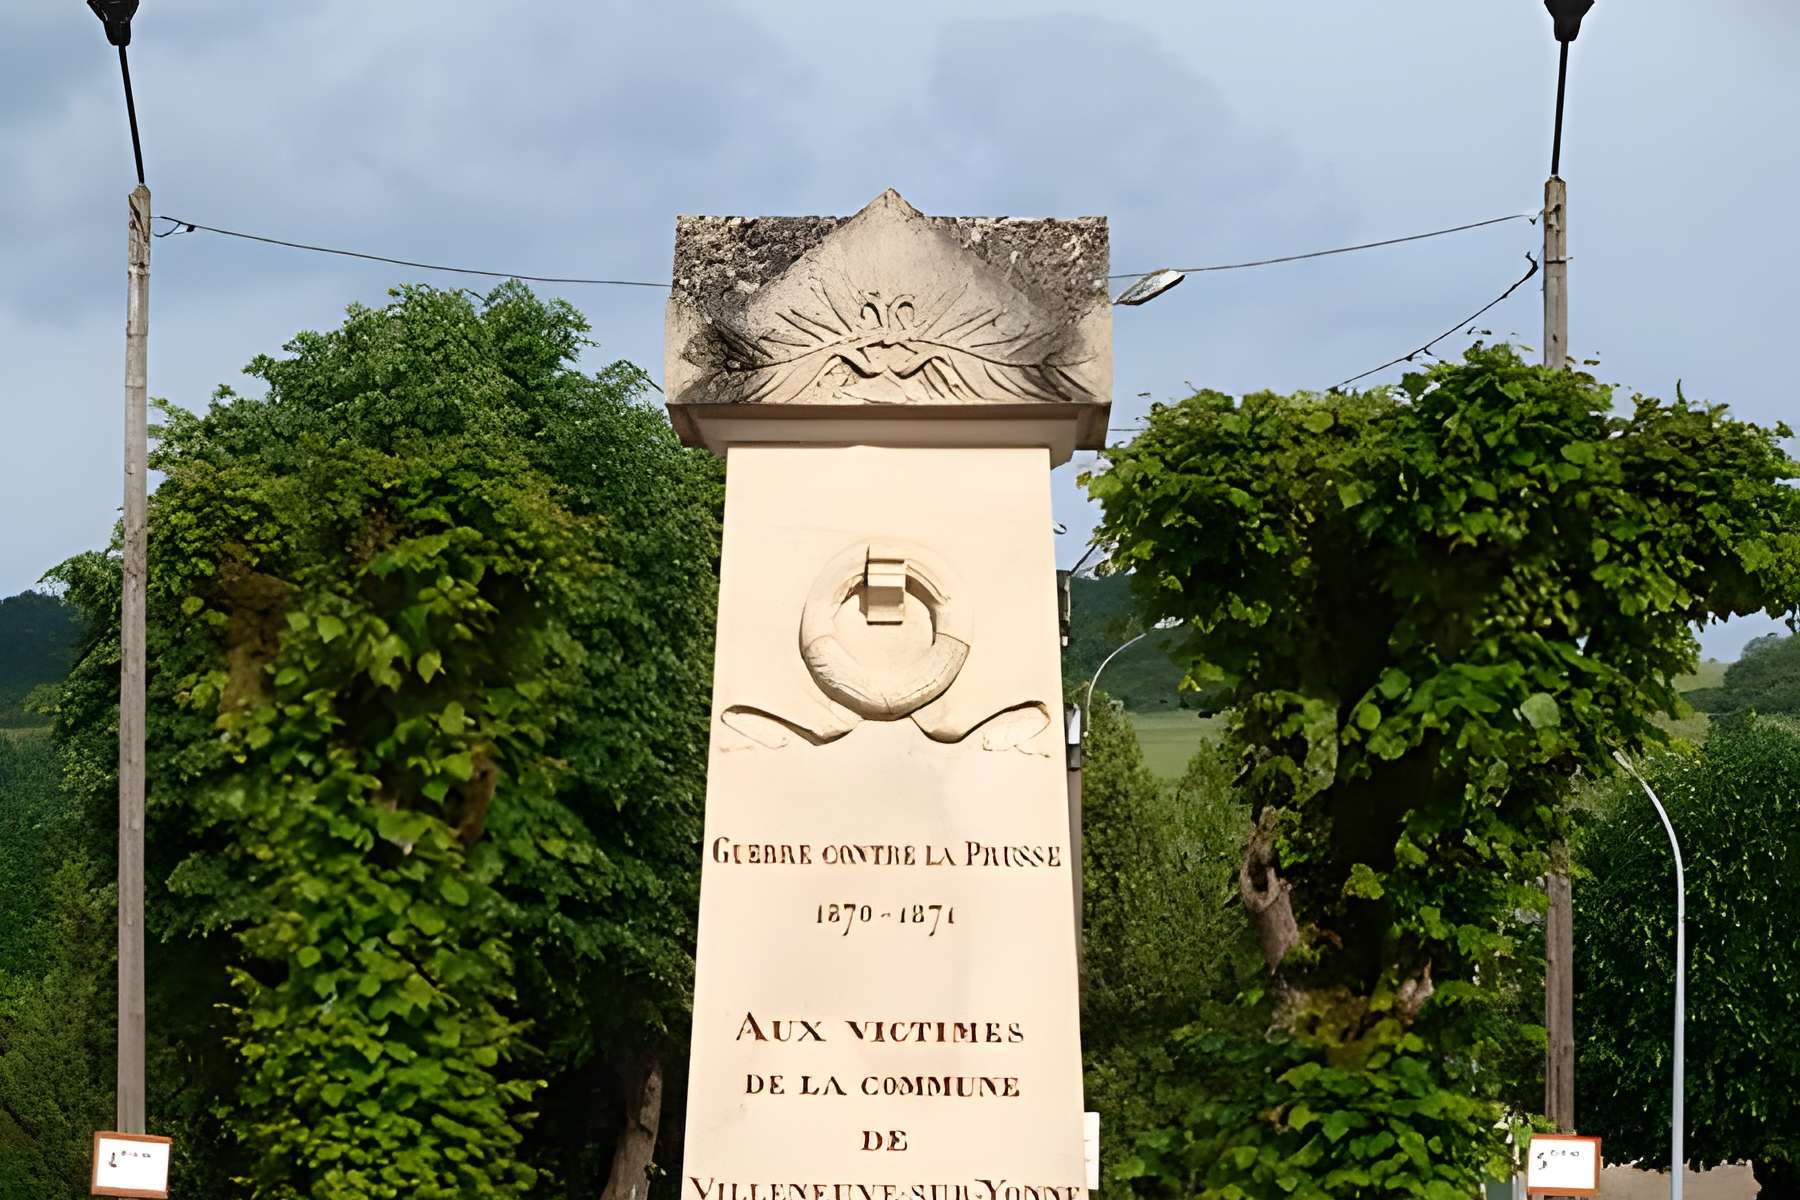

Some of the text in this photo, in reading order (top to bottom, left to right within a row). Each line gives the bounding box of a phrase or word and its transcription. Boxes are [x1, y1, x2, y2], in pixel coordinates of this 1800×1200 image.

[926, 845, 957, 866] LA
[736, 1012, 1024, 1043] AUX VICTIMES
[745, 1074, 1020, 1097] DE LA COMMUNE
[861, 1130, 908, 1152] DE
